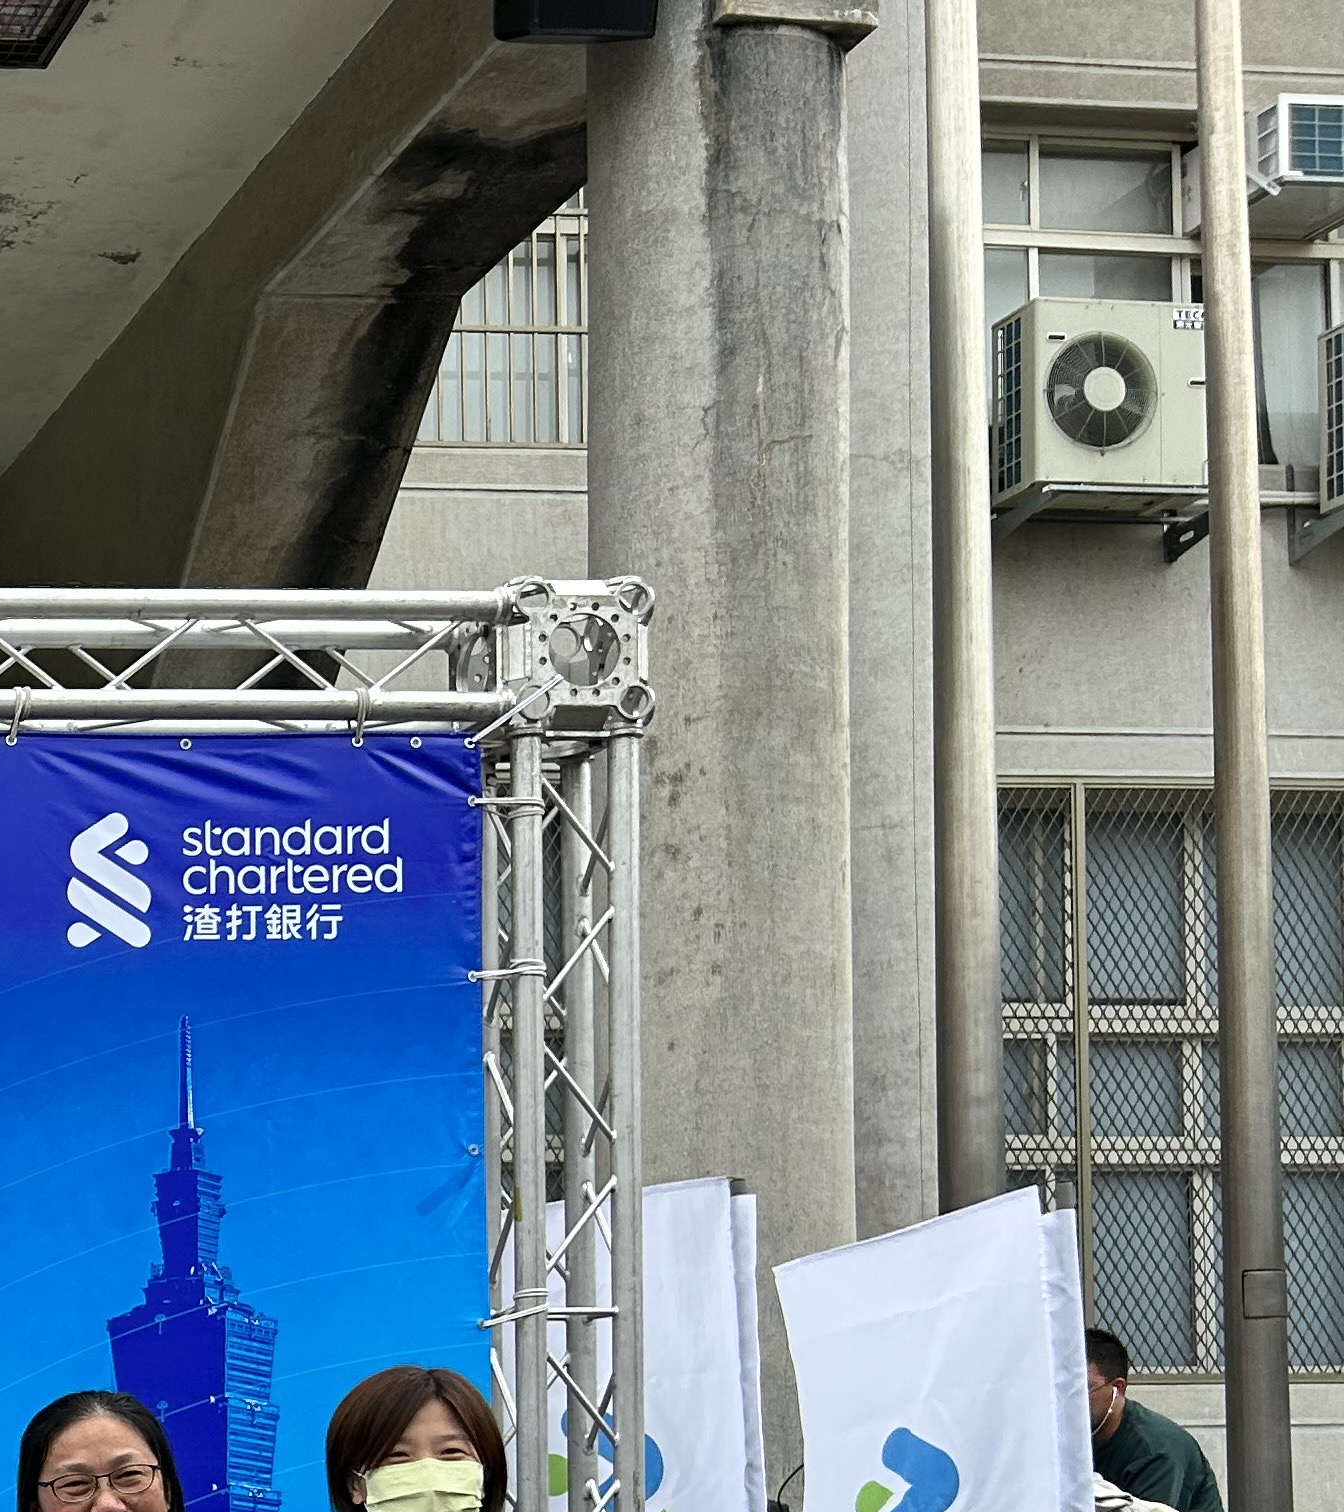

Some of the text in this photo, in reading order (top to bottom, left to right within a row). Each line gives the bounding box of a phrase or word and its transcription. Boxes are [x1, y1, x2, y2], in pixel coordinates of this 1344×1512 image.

[182, 817, 390, 857] standard
[182, 856, 403, 895] chartered
[183, 904, 343, 941] 渣打銀行
